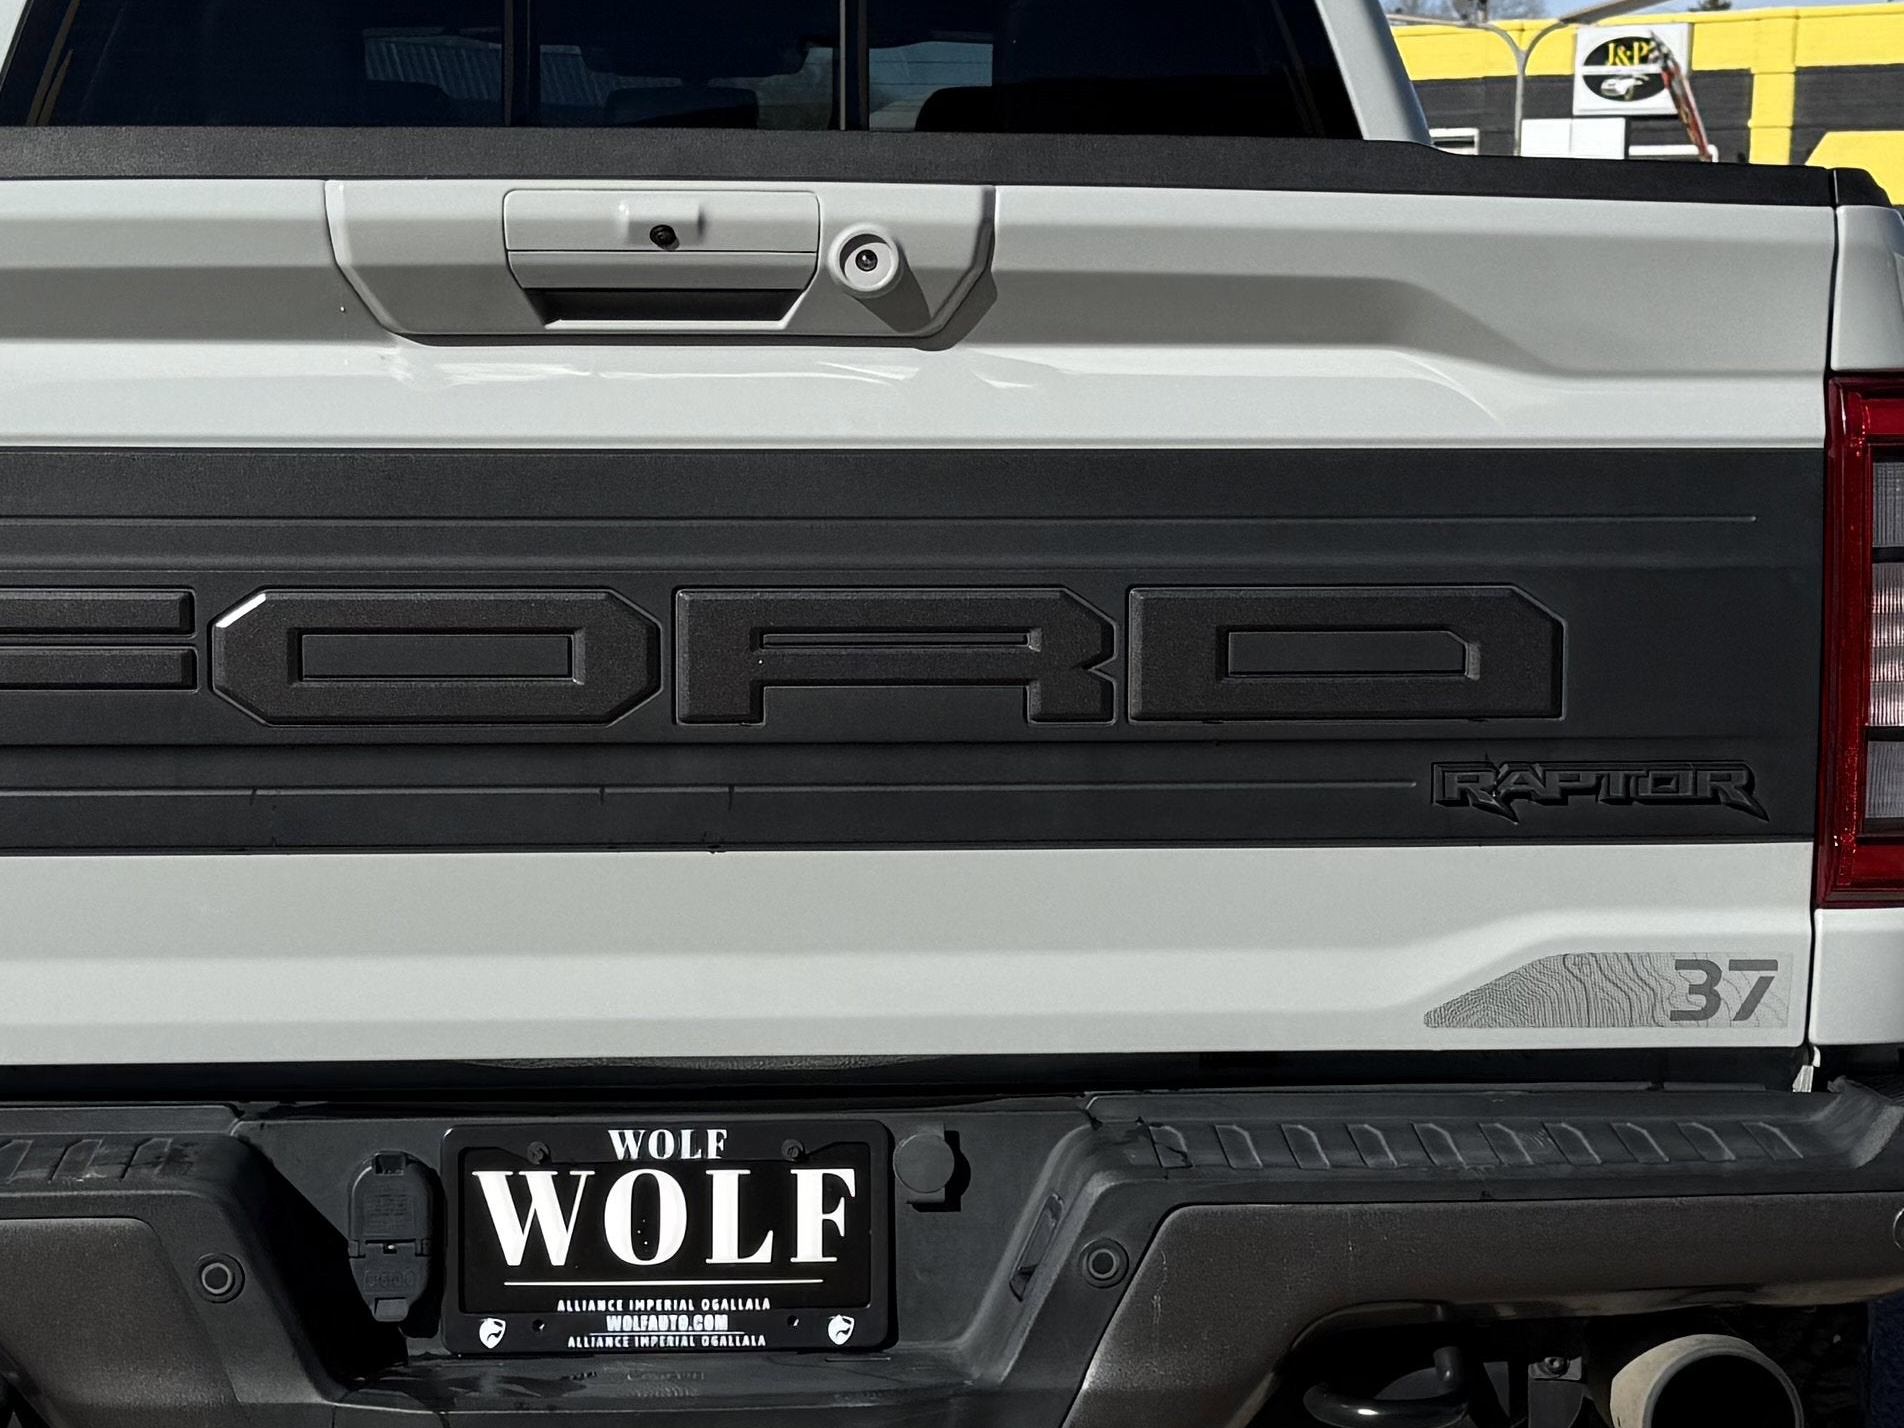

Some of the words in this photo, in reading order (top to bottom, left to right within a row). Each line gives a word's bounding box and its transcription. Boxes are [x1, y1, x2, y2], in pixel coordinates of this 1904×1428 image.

[1430, 760, 1770, 824] RAPTOR
[1669, 958, 1779, 1022] 37
[607, 1129, 728, 1160] WOLF
[472, 1168, 857, 1266] WOLF
[557, 1299, 623, 1312] ALLIANCE
[629, 1299, 695, 1311] IMPERIAL
[701, 1298, 771, 1311] OGALLALA
[606, 1314, 728, 1332] WOLFAUTO.COM
[567, 1336, 629, 1348] ALLIANCE
[635, 1335, 696, 1347] IMPERIAL
[701, 1335, 766, 1347] OGALLALA
